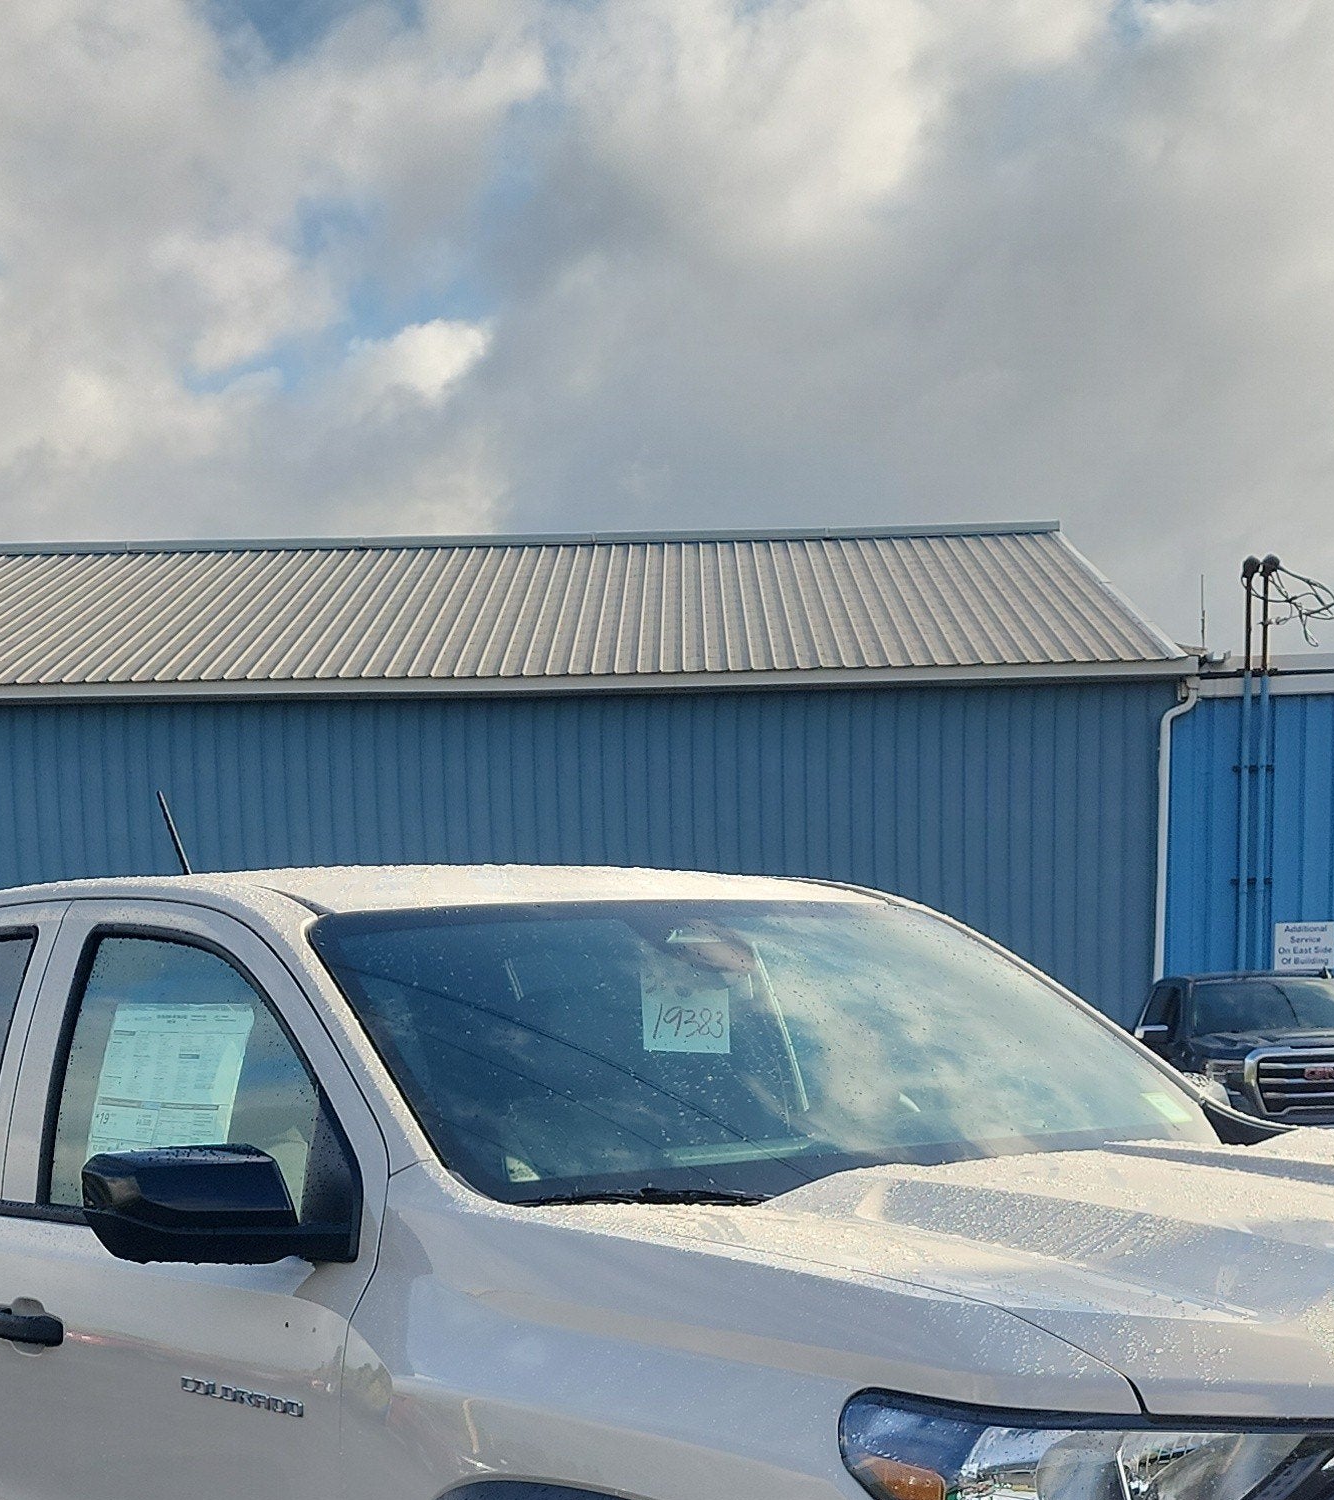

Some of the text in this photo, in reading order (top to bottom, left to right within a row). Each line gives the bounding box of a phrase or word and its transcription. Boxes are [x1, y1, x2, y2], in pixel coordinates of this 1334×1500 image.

[1284, 925, 1328, 933] Additional
[1278, 946, 1332, 954] On East Side
[1281, 956, 1329, 966] Of Building
[652, 1003, 724, 1039] 19383
[180, 1375, 304, 1418] COLORADO
